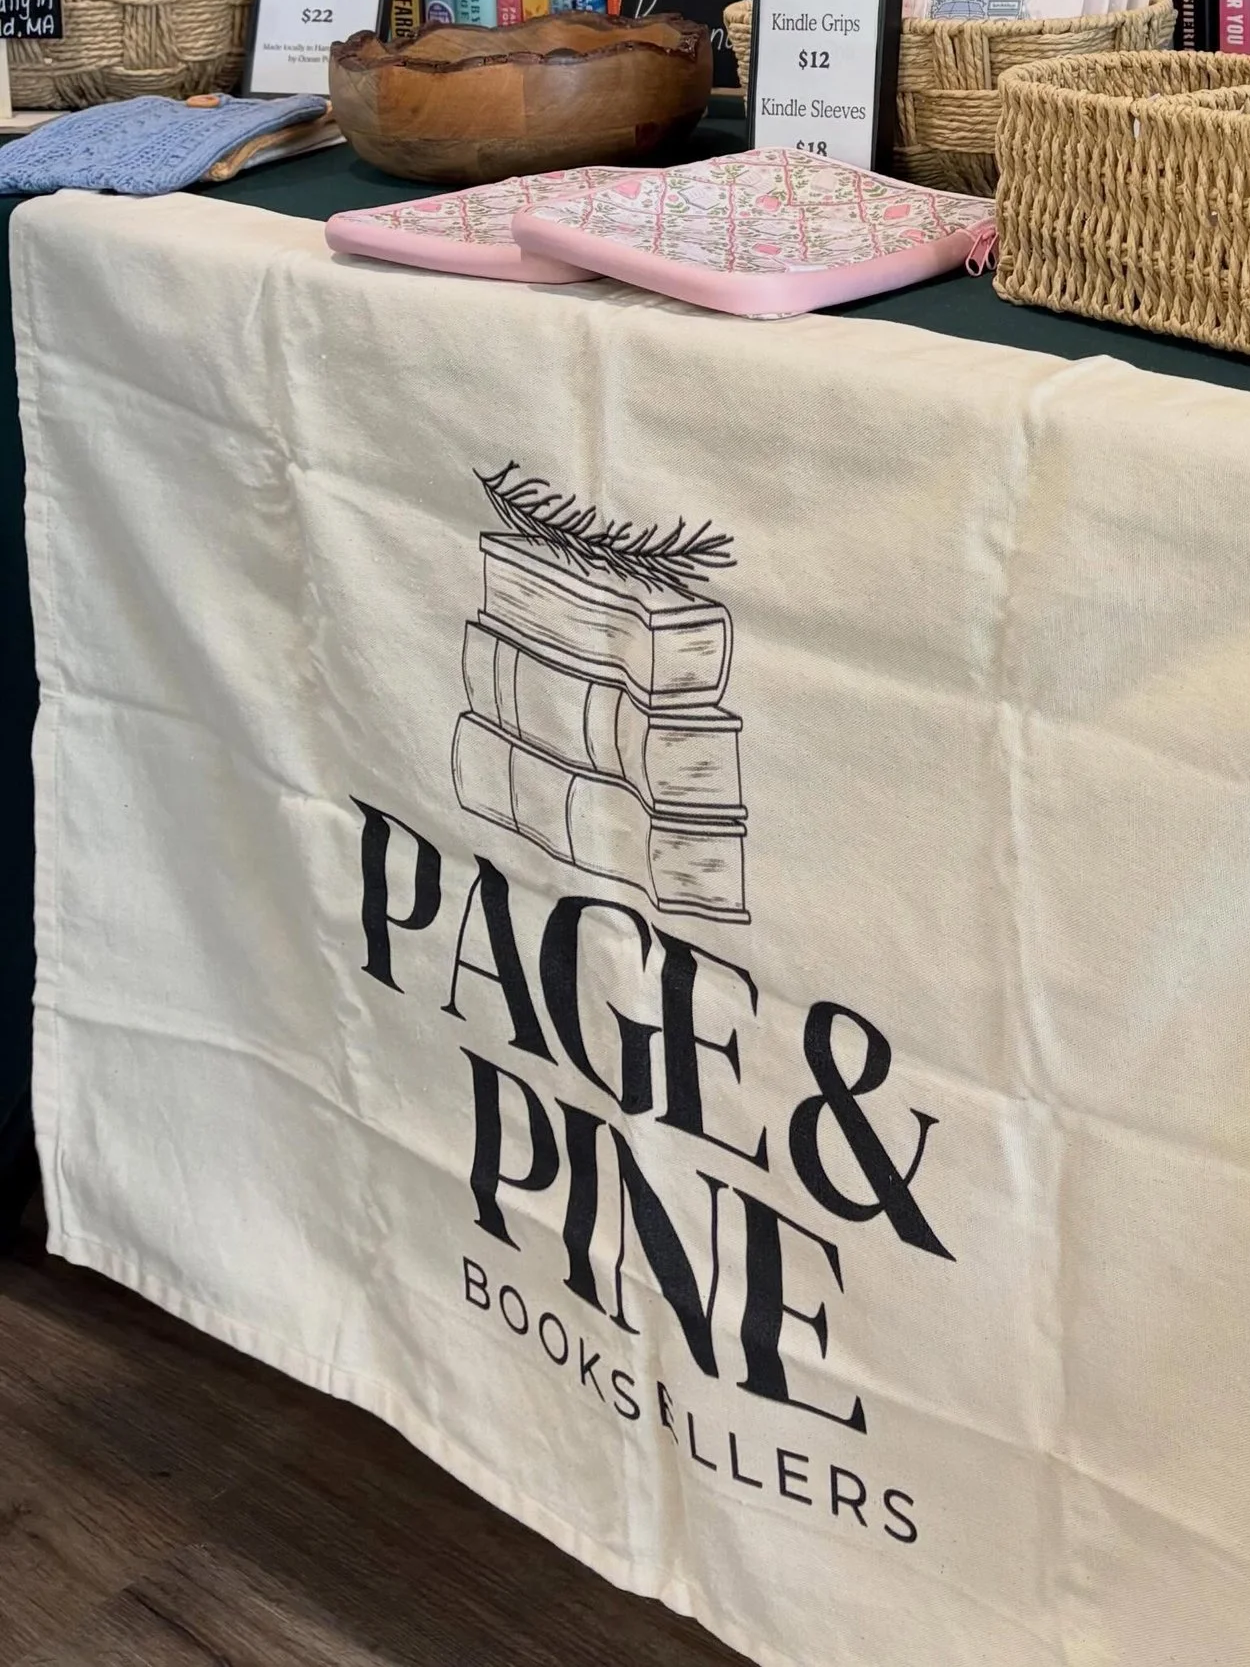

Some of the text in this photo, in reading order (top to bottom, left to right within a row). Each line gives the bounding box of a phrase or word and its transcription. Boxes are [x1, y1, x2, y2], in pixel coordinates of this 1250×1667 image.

[301, 8, 334, 24] $22
[772, 13, 861, 35] Kindle Grips
[798, 50, 831, 69] $12
[761, 98, 866, 120] Kindle Sleeves
[351, 794, 957, 1263] PAGE &
[460, 1046, 869, 1436] PINE
[461, 1256, 919, 1546] BOOKSELLERS
